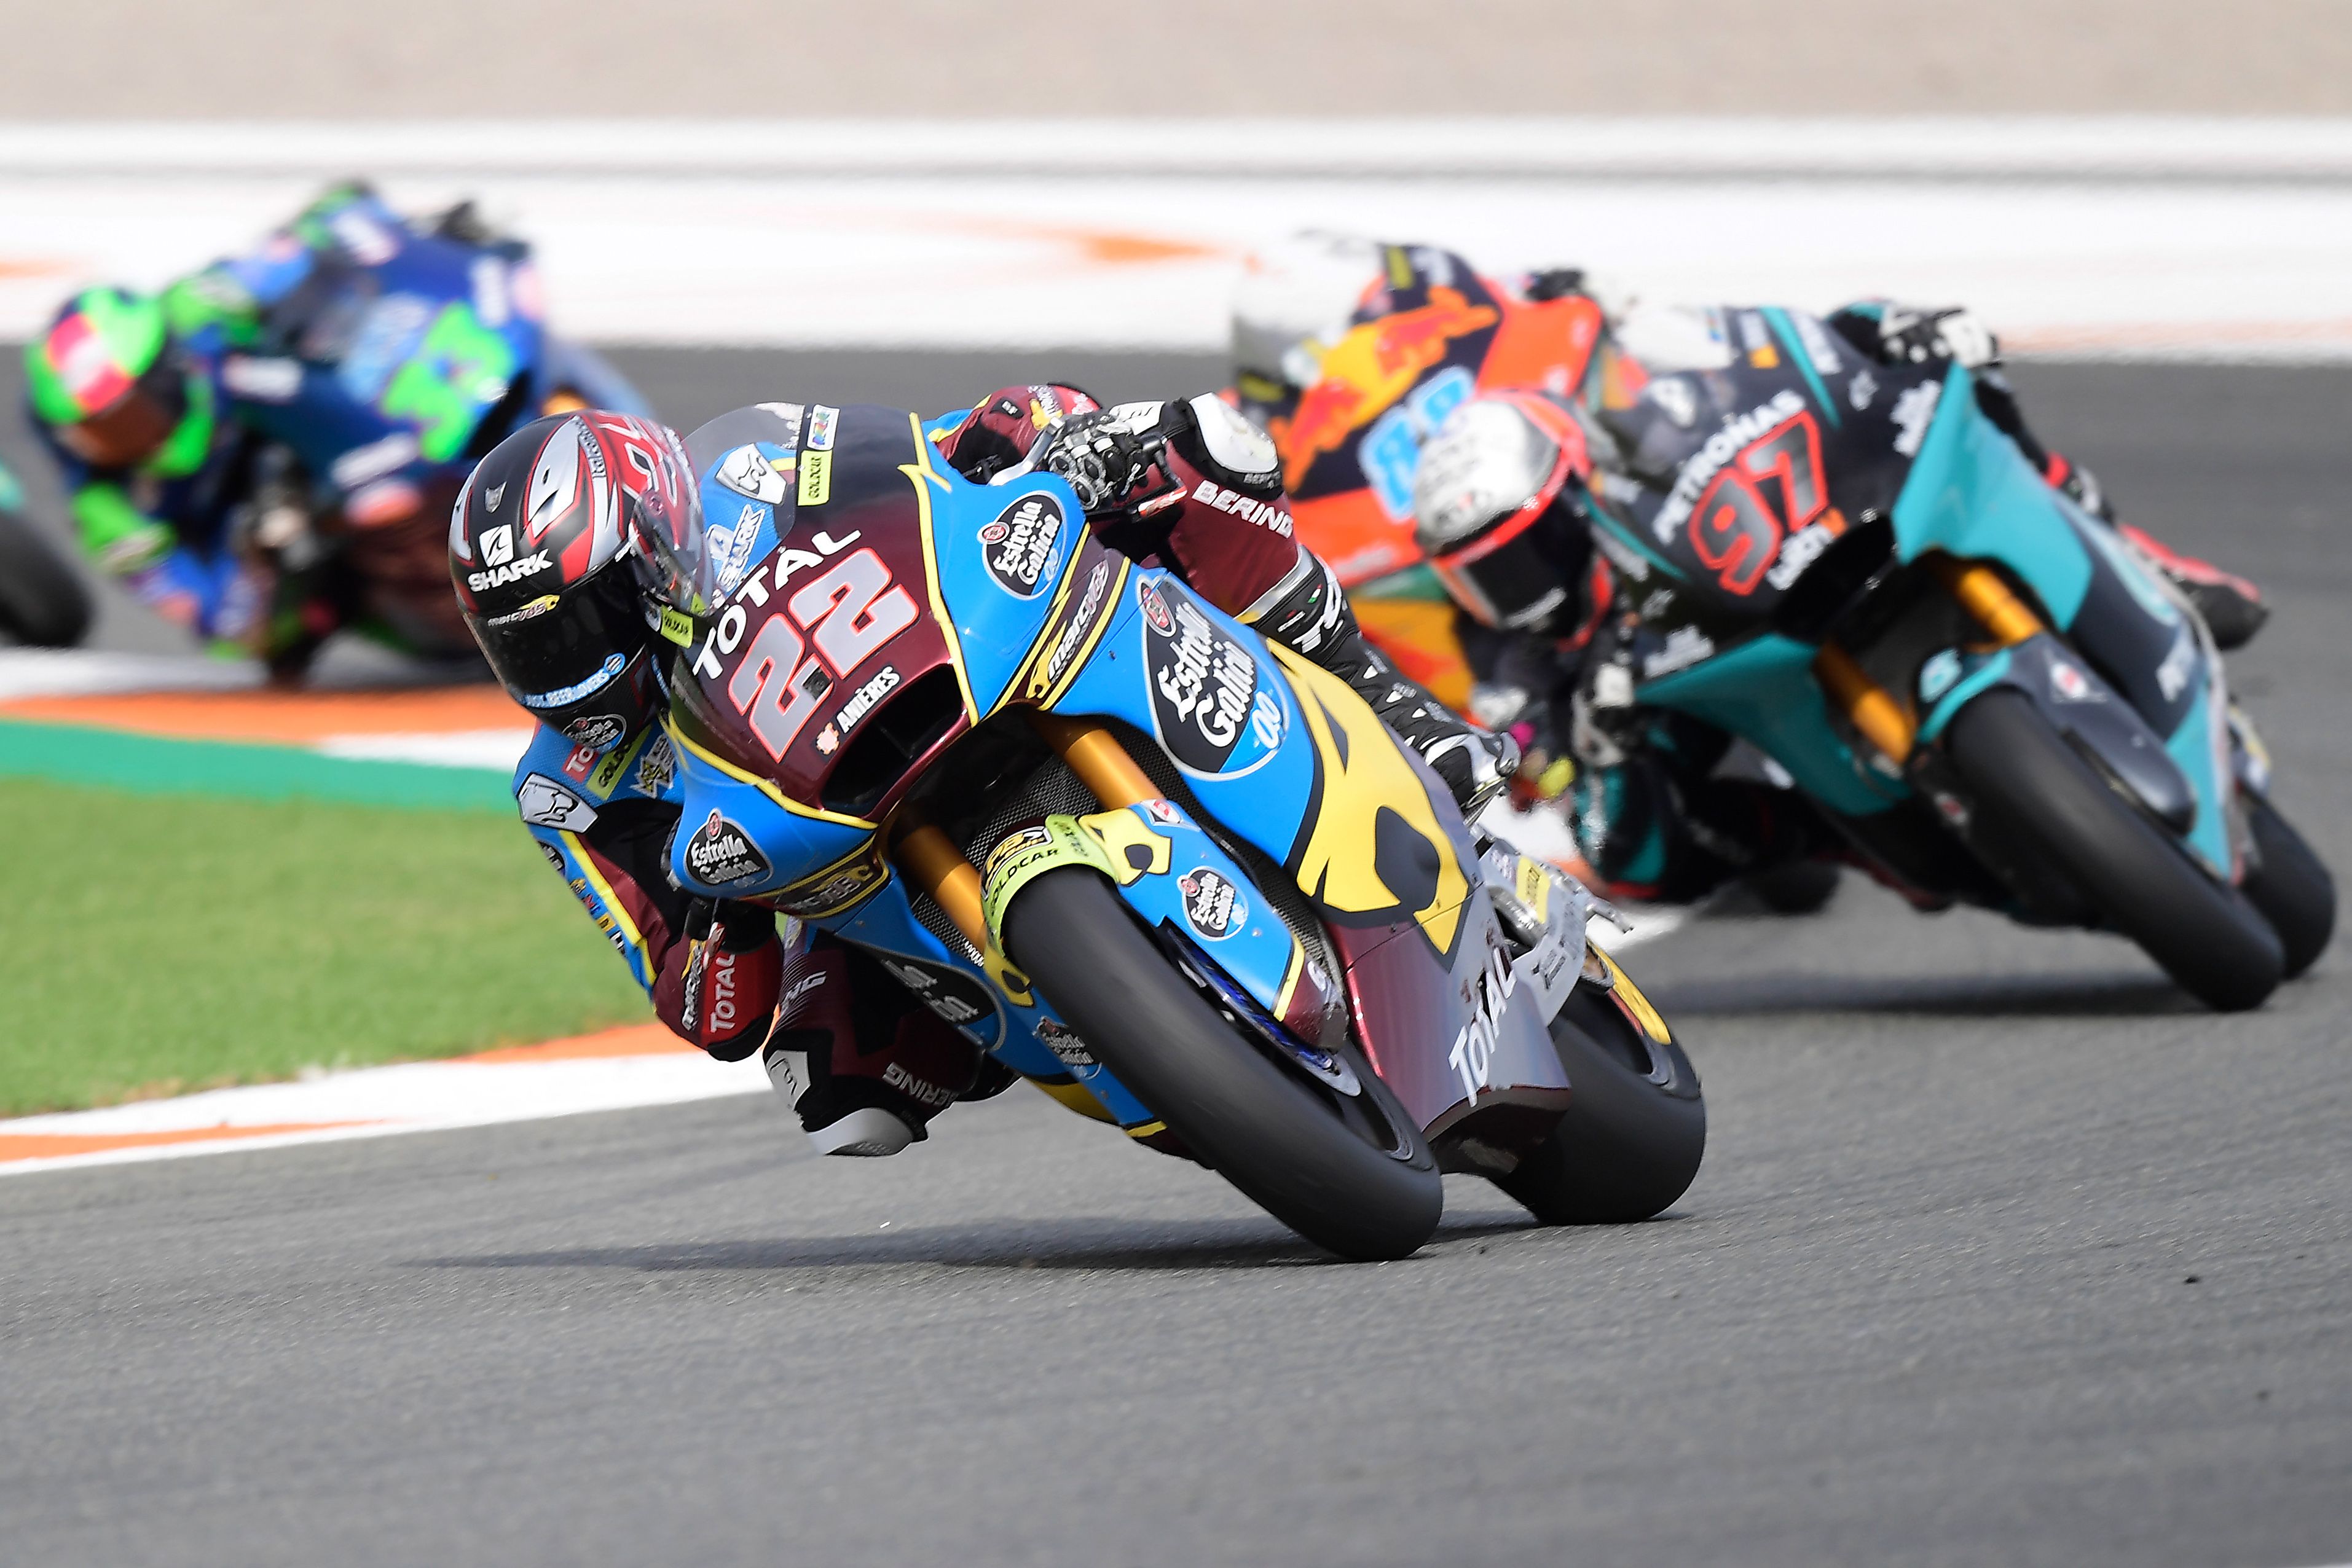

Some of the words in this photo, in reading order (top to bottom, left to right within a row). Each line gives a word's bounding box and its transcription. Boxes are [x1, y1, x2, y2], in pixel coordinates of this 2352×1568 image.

[468, 548, 553, 592] SHARK
[1688, 410, 1829, 595] 97
[692, 529, 862, 679] TOTAL
[727, 546, 920, 764] 22
[1157, 602, 1214, 723] Estrella
[1195, 641, 1254, 748] Galicia
[691, 833, 748, 868] Estrella
[710, 954, 736, 1033] TOTAL
[1448, 947, 1517, 1107] TOTAL
